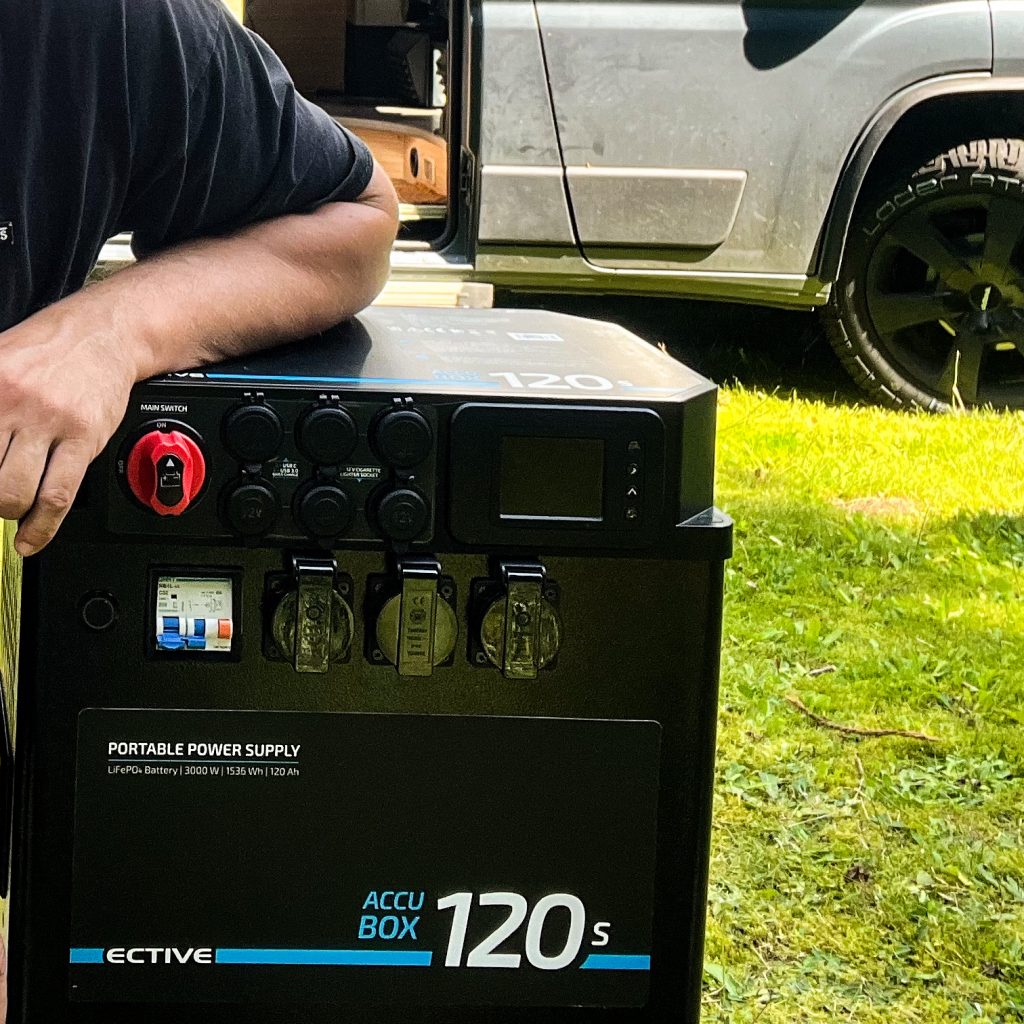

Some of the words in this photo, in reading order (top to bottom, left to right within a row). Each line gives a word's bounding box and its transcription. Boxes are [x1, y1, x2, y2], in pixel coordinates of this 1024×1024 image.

[489, 372, 613, 391] 120
[160, 404, 188, 413] SWITCH
[108, 742, 184, 756] PORTABLE
[187, 743, 242, 757] POWER
[245, 744, 301, 757] SUPPLY
[144, 765, 178, 776] Battery
[184, 766, 208, 775] 3000
[209, 766, 221, 775] W
[226, 767, 247, 776] 1536
[248, 767, 264, 776] Wh
[270, 767, 286, 776] 120
[287, 767, 300, 776] Ah
[362, 891, 425, 911] ACCU
[358, 915, 420, 940] BOX
[437, 891, 586, 970] 120
[106, 947, 212, 964] ECTIVE
